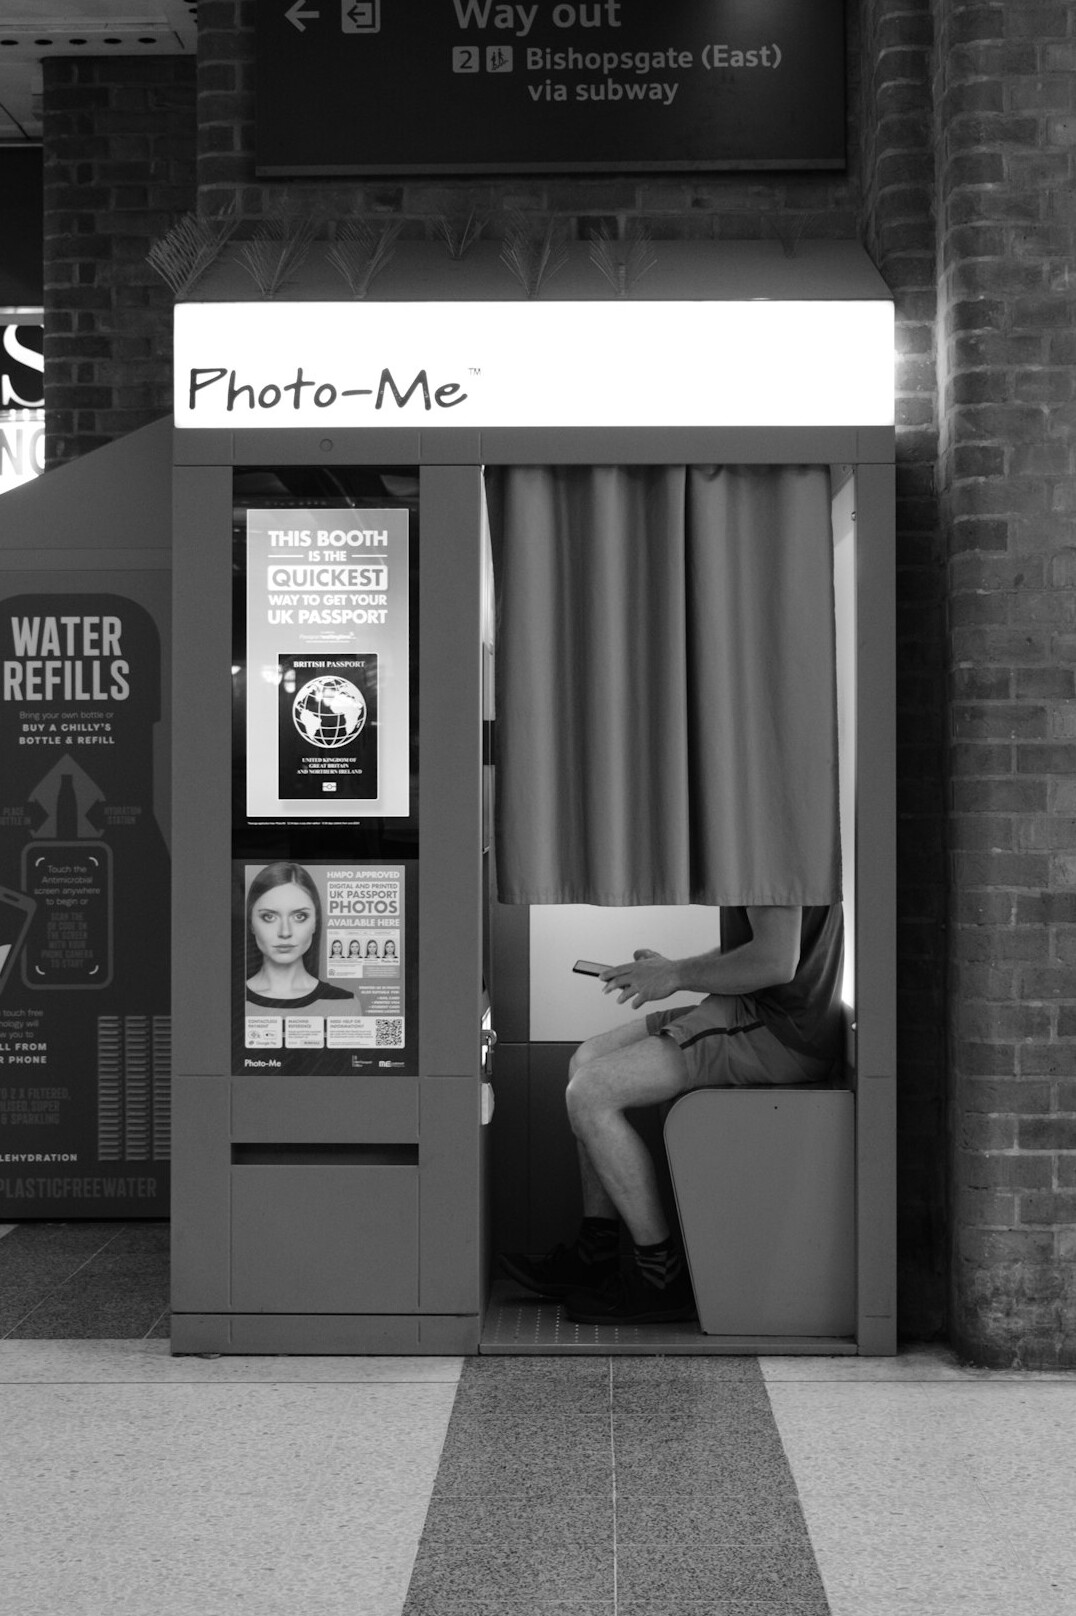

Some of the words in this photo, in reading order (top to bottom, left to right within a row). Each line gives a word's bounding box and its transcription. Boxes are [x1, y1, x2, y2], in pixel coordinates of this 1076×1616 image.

[454, 0, 539, 36] Way
[552, 0, 622, 28] out
[459, 50, 474, 70] 2
[526, 46, 694, 74] Bishopsgate
[701, 44, 783, 69] (East)
[528, 80, 567, 102] via
[576, 79, 679, 105] subway
[189, 367, 467, 411] Photo-Me
[267, 530, 312, 547] THIS
[317, 530, 388, 547] BOOTH
[308, 550, 320, 562] IS
[323, 550, 347, 562] THE
[272, 568, 384, 588] QUICKEST
[268, 594, 300, 606] WAY
[302, 594, 320, 606] TO
[323, 594, 347, 606] GET
[349, 594, 388, 606] YOUR
[267, 609, 294, 624] UK
[298, 609, 388, 624] PASSPORT
[11, 616, 122, 657] WATER
[3, 659, 130, 701] REFILLS
[19, 711, 40, 721] Bring
[42, 713, 59, 721] your
[80, 711, 104, 719] bottle
[22, 724, 45, 732] BUY
[49, 724, 57, 732] A
[61, 723, 112, 732] CHILLY'S
[19, 736, 61, 745] BOTTLE
[66, 736, 73, 745] &
[78, 736, 115, 744] REFILL
[47, 865, 71, 873] Touch
[73, 865, 87, 873] the
[41, 876, 93, 884] Antimicrobial
[327, 871, 354, 879] HMPO
[355, 871, 400, 879] APPROVED
[62, 887, 101, 896] anywhere
[329, 890, 344, 899] UK
[347, 890, 398, 899] PASSPORT
[56, 897, 78, 907] begin
[329, 900, 398, 914] PHOTOS
[327, 918, 375, 927] AVAILABLE
[377, 918, 400, 927] HERE
[3, 1009, 26, 1017] touch
[27, 1009, 44, 1017] free
[26, 1019, 39, 1027] will
[9, 1032, 23, 1040] you
[25, 1030, 34, 1038] to
[15, 1042, 47, 1051] FROM
[8, 1055, 47, 1064] PHONE
[244, 1058, 282, 1068] Photo-Me
